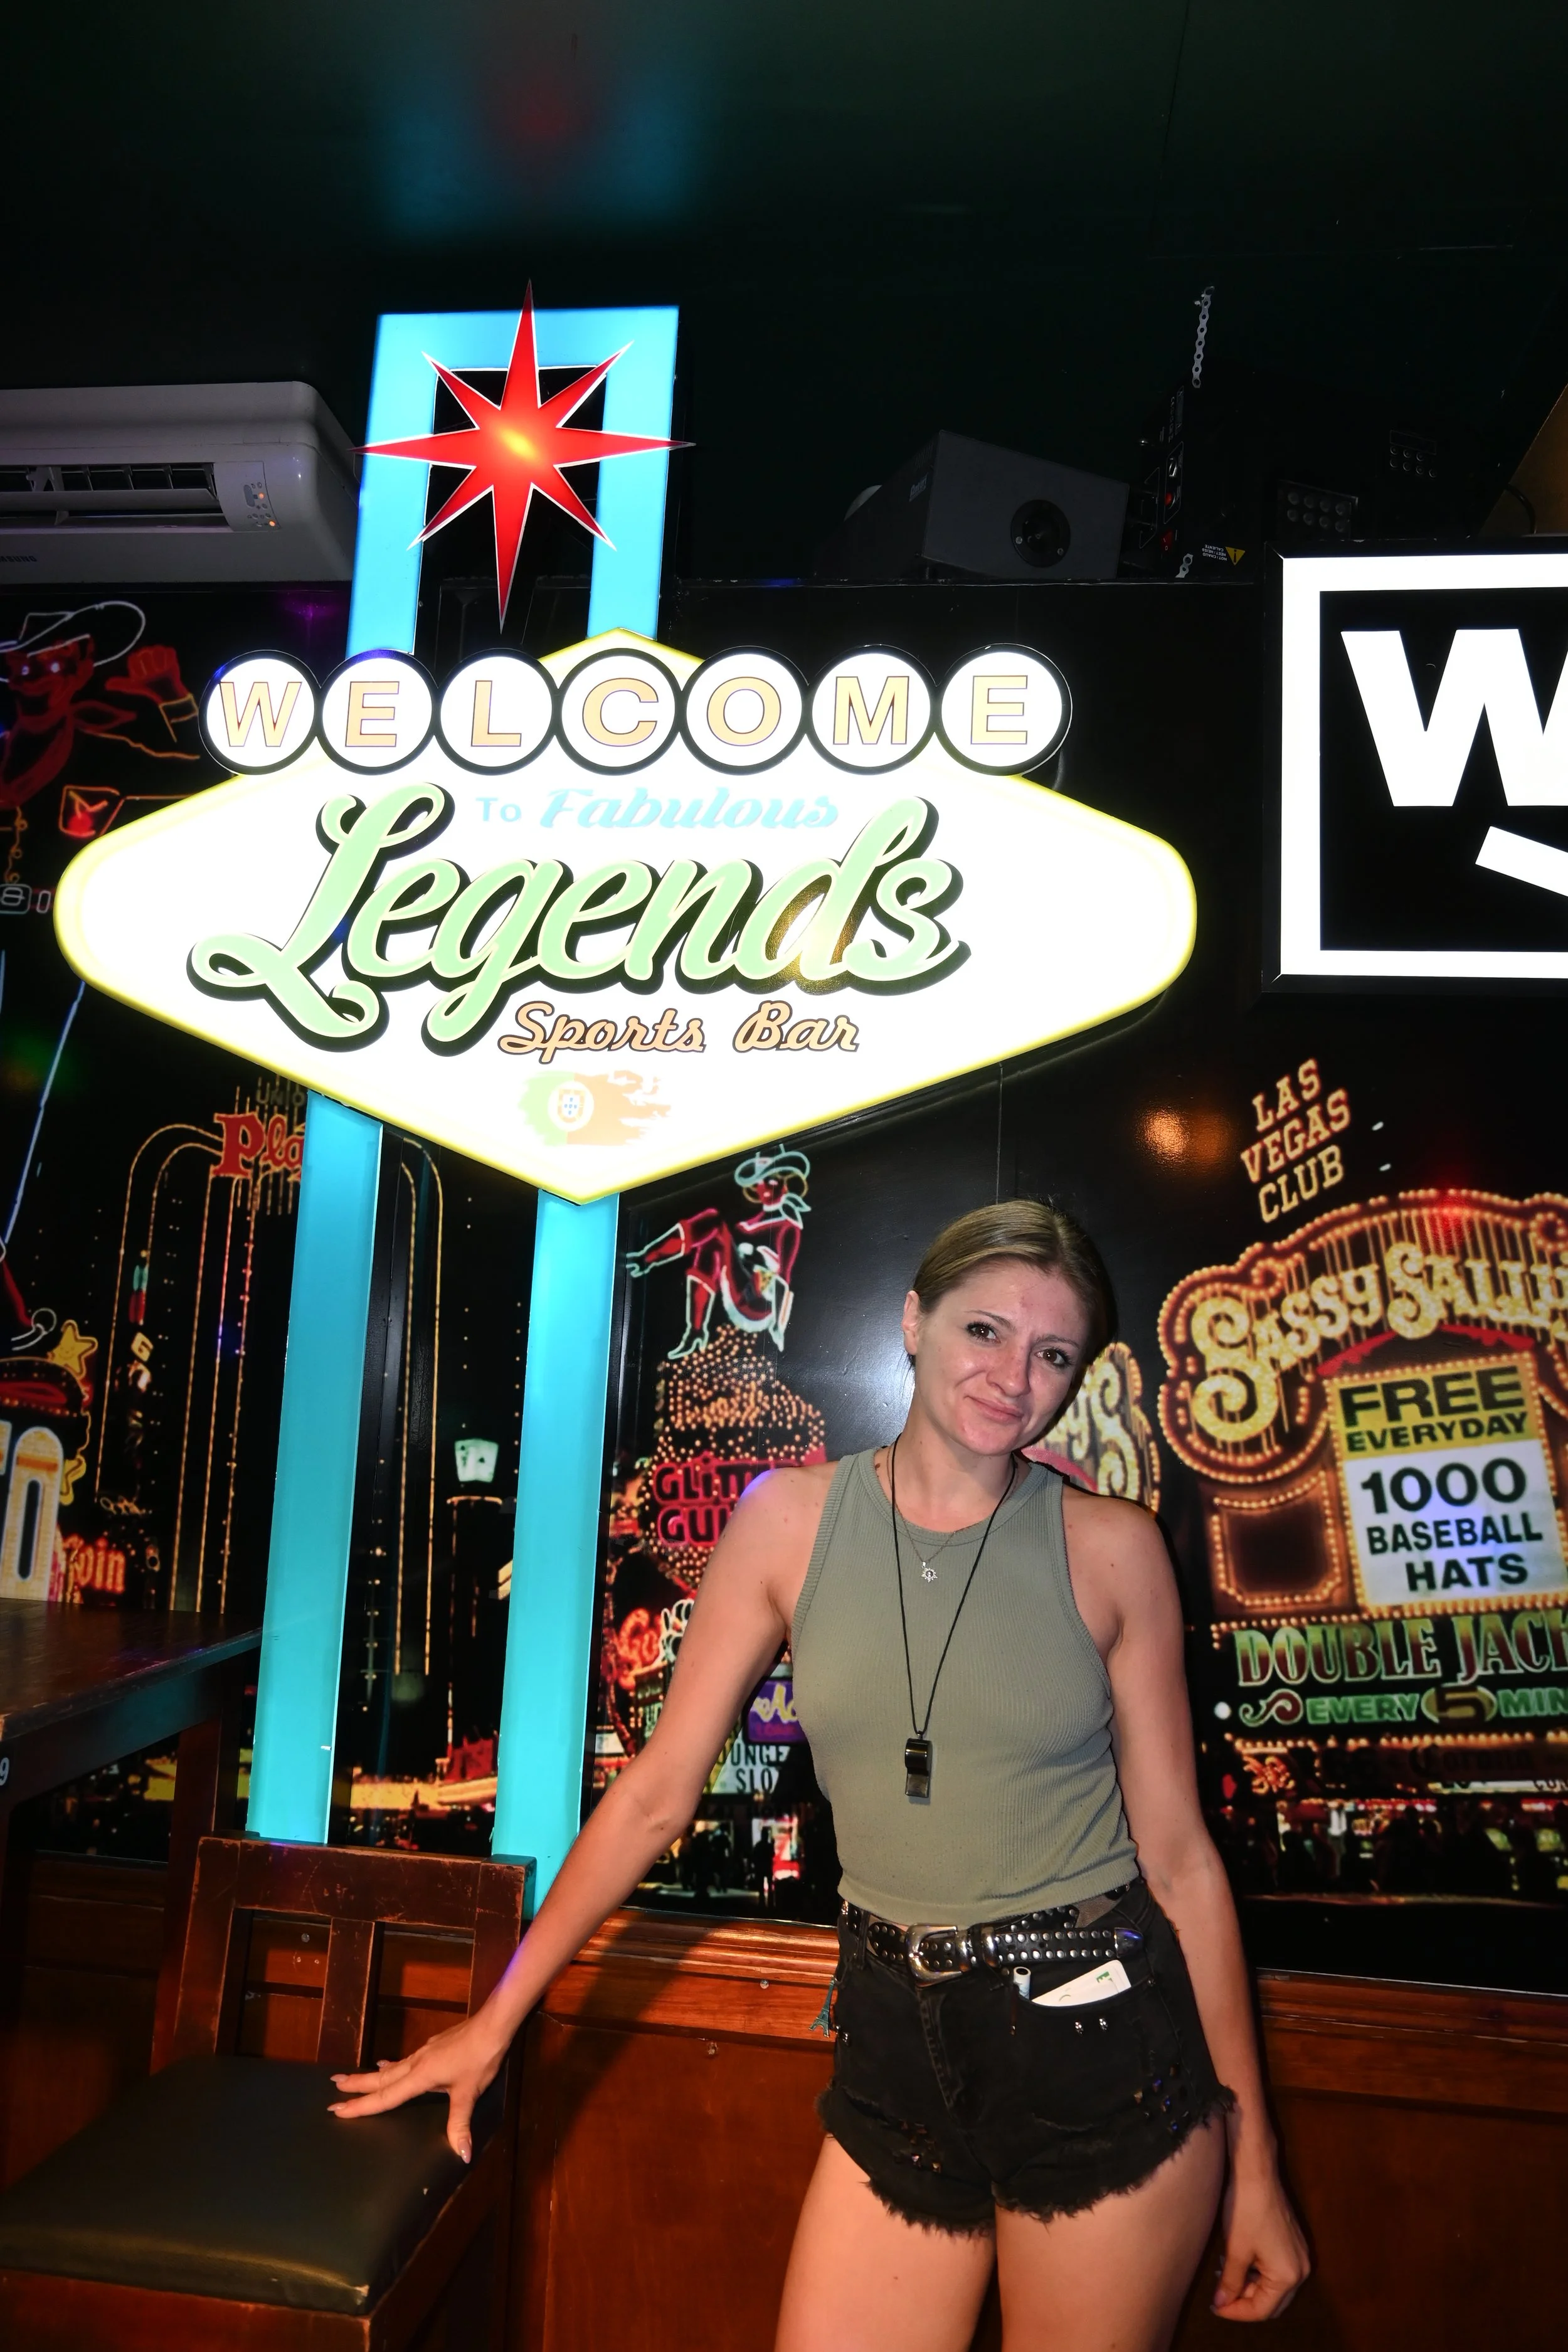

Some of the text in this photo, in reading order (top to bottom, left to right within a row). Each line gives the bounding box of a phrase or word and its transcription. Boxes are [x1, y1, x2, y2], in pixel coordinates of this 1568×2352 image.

[220, 674, 1027, 747] WELCOME
[475, 786, 839, 829] To Fabulous
[186, 781, 971, 1057] Legends
[497, 999, 860, 1064] Sports Bar
[1252, 1057, 1321, 1133] LAS
[1240, 1088, 1350, 1183] VEGAS
[1258, 1144, 1344, 1223] CLUB
[1338, 1365, 1525, 1428] FREE
[1345, 1411, 1528, 1453] EVERYDAY
[1360, 1456, 1527, 1515] 1000
[1366, 1512, 1543, 1555] BASEBALL
[1405, 1552, 1528, 1592] HATS
[1233, 1617, 1443, 1687] DOUBLE
[1305, 1692, 1420, 1725] EVERY
